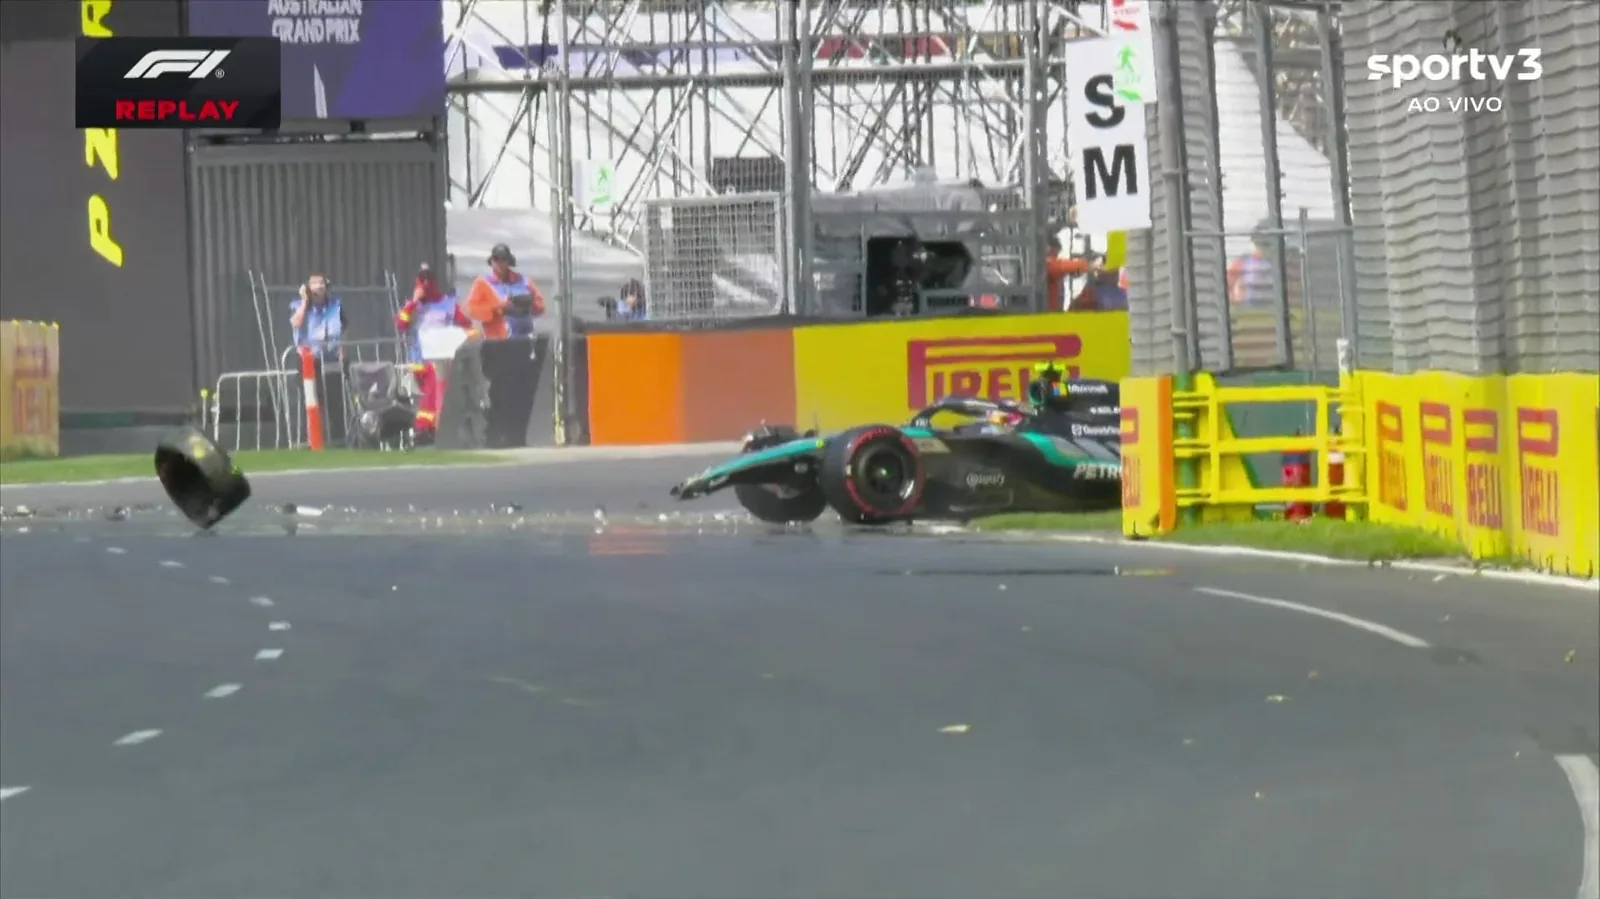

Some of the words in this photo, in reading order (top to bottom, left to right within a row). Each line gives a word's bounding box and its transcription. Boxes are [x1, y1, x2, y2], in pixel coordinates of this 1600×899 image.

[271, 18, 324, 43] GRAND
[325, 18, 361, 43] PRIX
[1084, 74, 1125, 128] S
[1083, 145, 1138, 200] M
